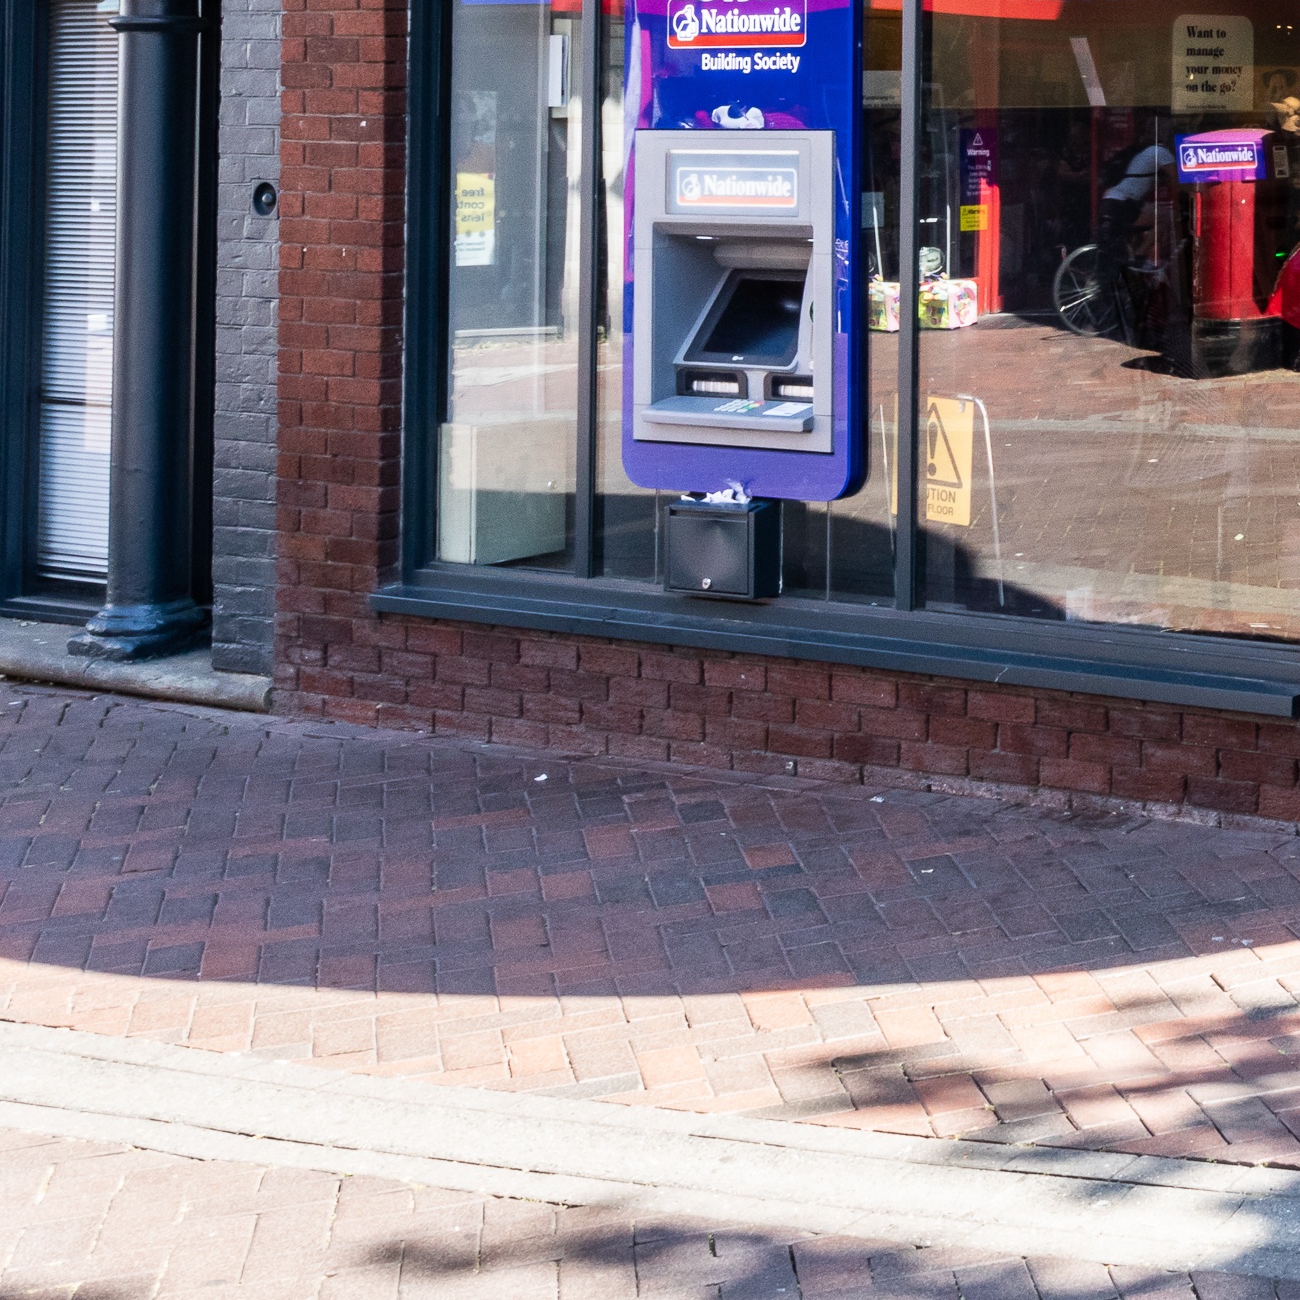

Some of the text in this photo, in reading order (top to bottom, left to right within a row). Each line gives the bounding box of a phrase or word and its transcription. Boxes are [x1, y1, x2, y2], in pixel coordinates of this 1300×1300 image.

[701, 7, 801, 34] Nationwide
[1186, 25, 1227, 39] Want to
[1186, 46, 1225, 59] manage
[701, 52, 800, 74] Building Society
[1185, 65, 1243, 78] your money
[1185, 80, 1237, 97] on the go?
[967, 149, 990, 157] Warning
[1197, 147, 1254, 163] Nationwide
[703, 174, 791, 197] Nationwide
[928, 504, 953, 516] FLOOR
